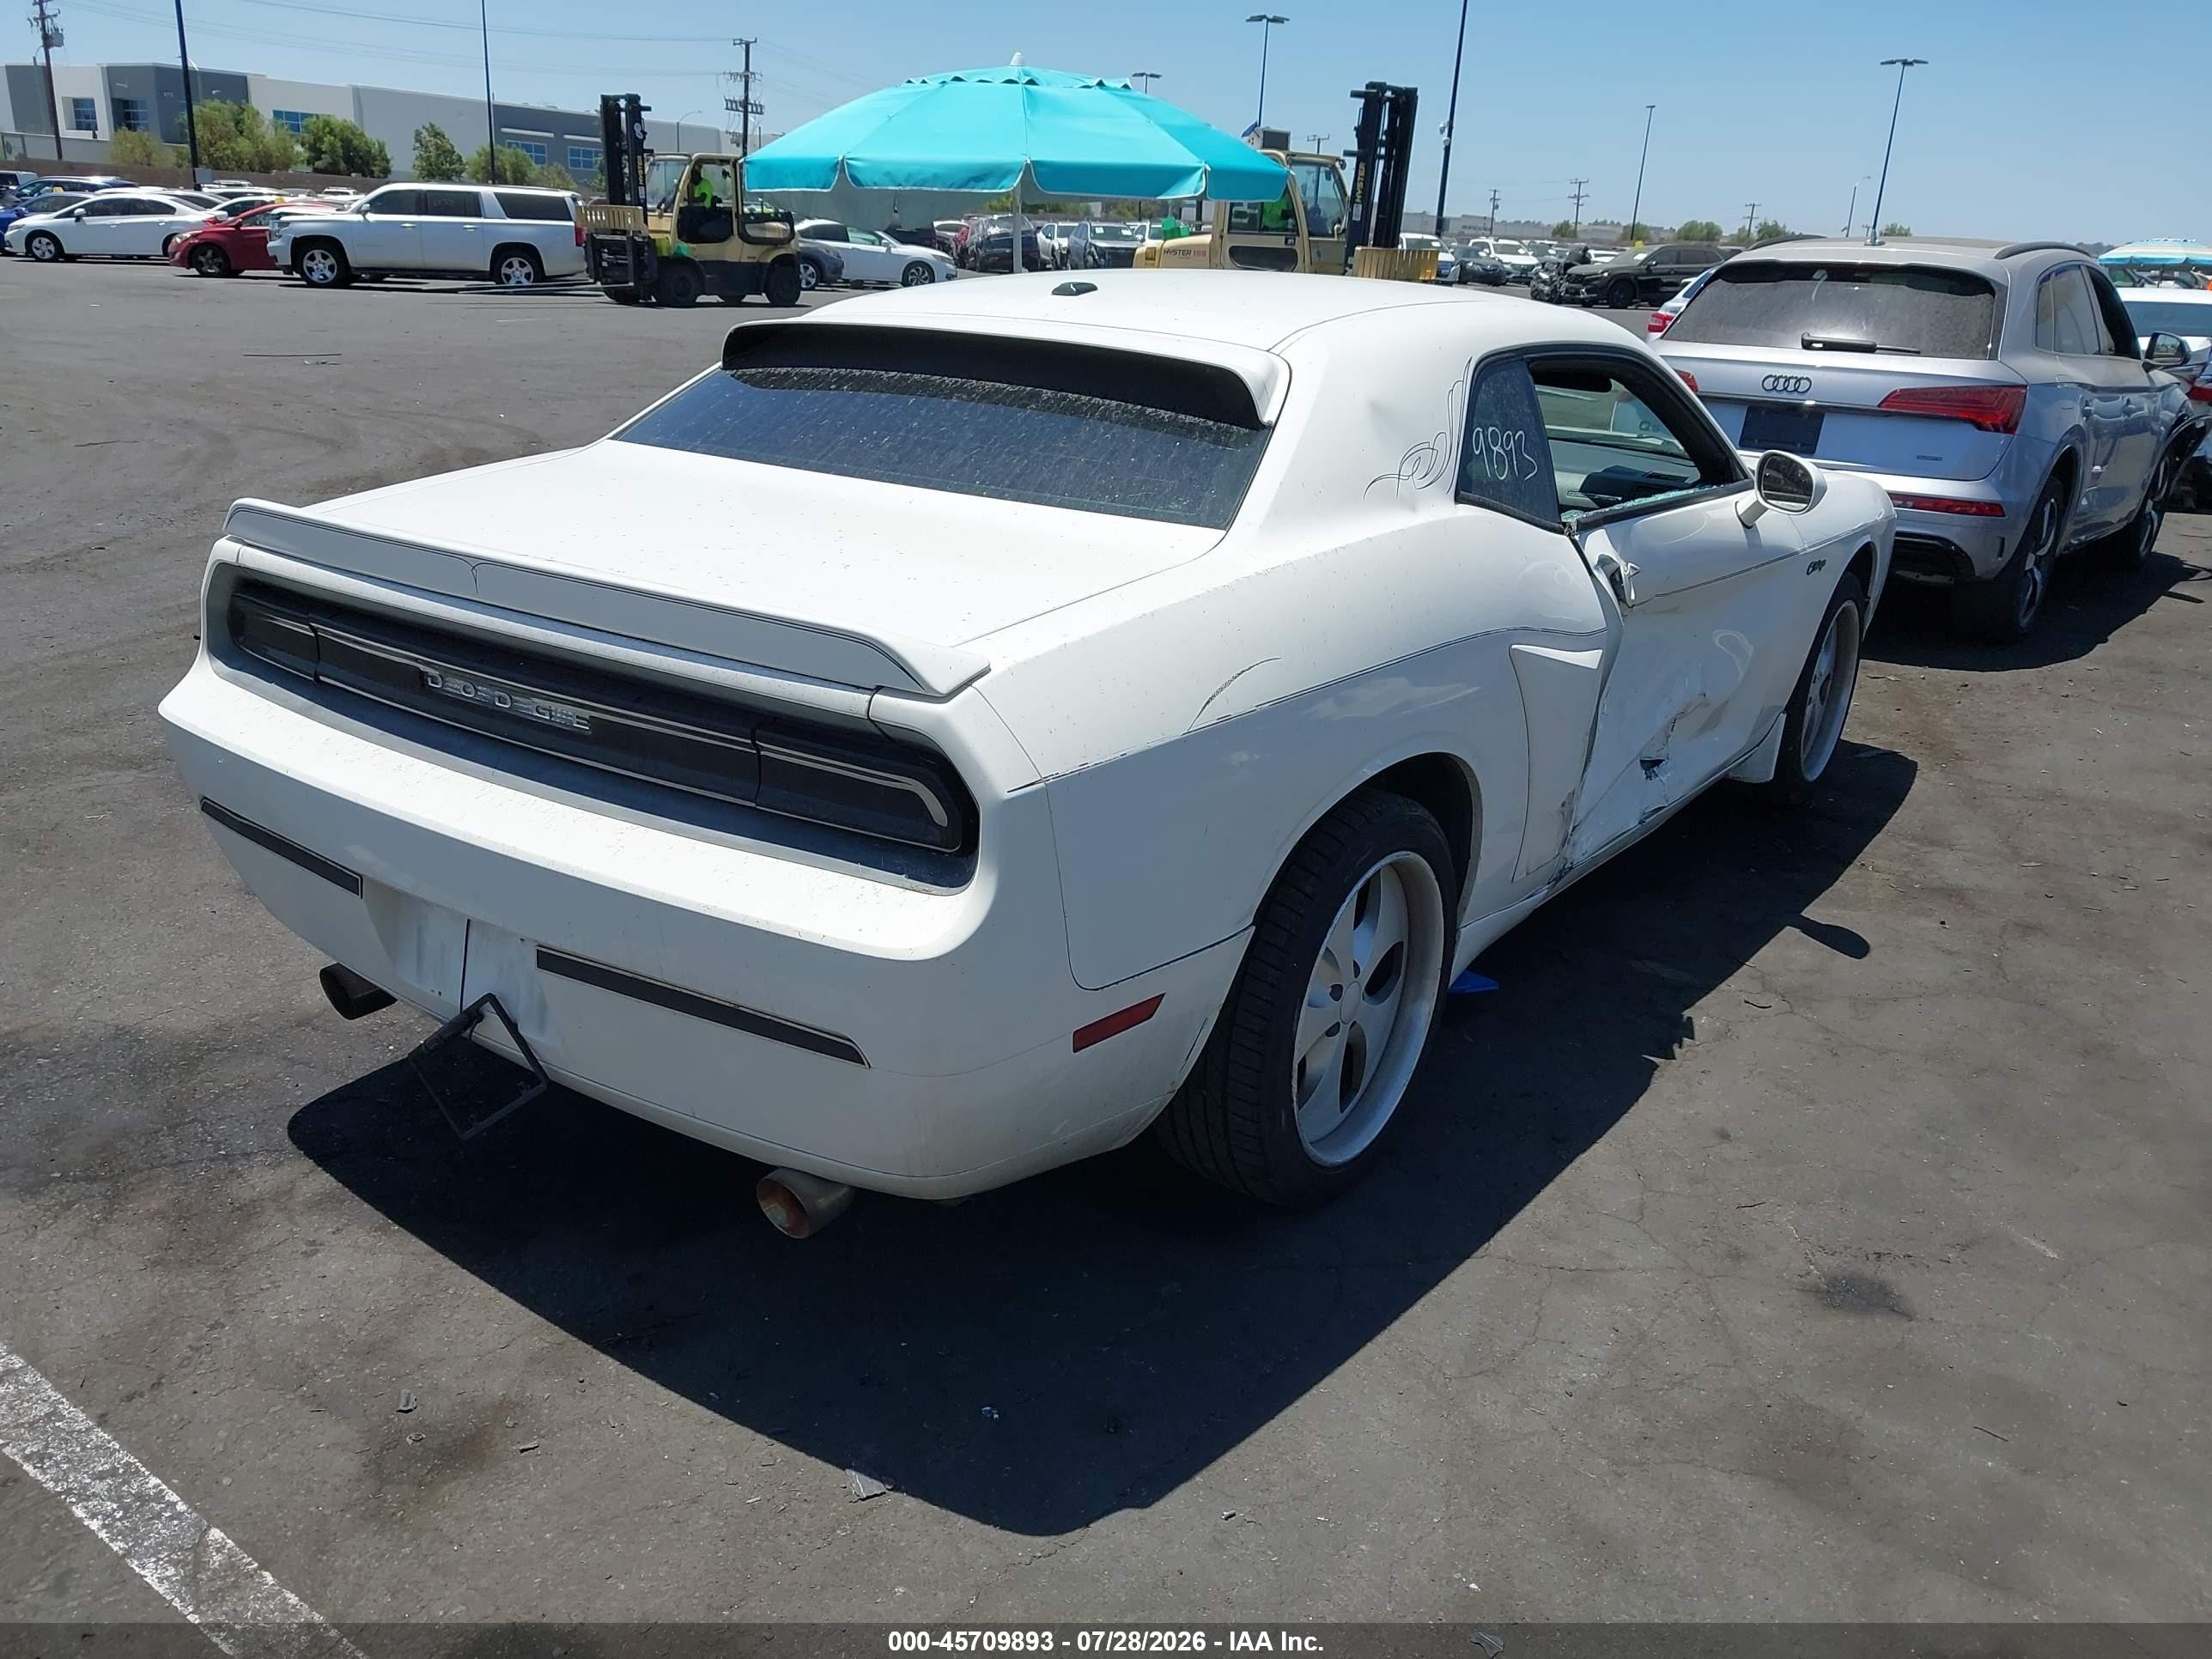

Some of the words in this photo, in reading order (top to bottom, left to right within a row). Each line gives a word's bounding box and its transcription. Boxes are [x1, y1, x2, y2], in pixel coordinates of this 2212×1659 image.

[1355, 161, 1366, 203] HYSTER
[1164, 248, 1192, 257] HYSTER
[1472, 426, 1538, 481] 9893
[426, 670, 592, 730] DODGE
